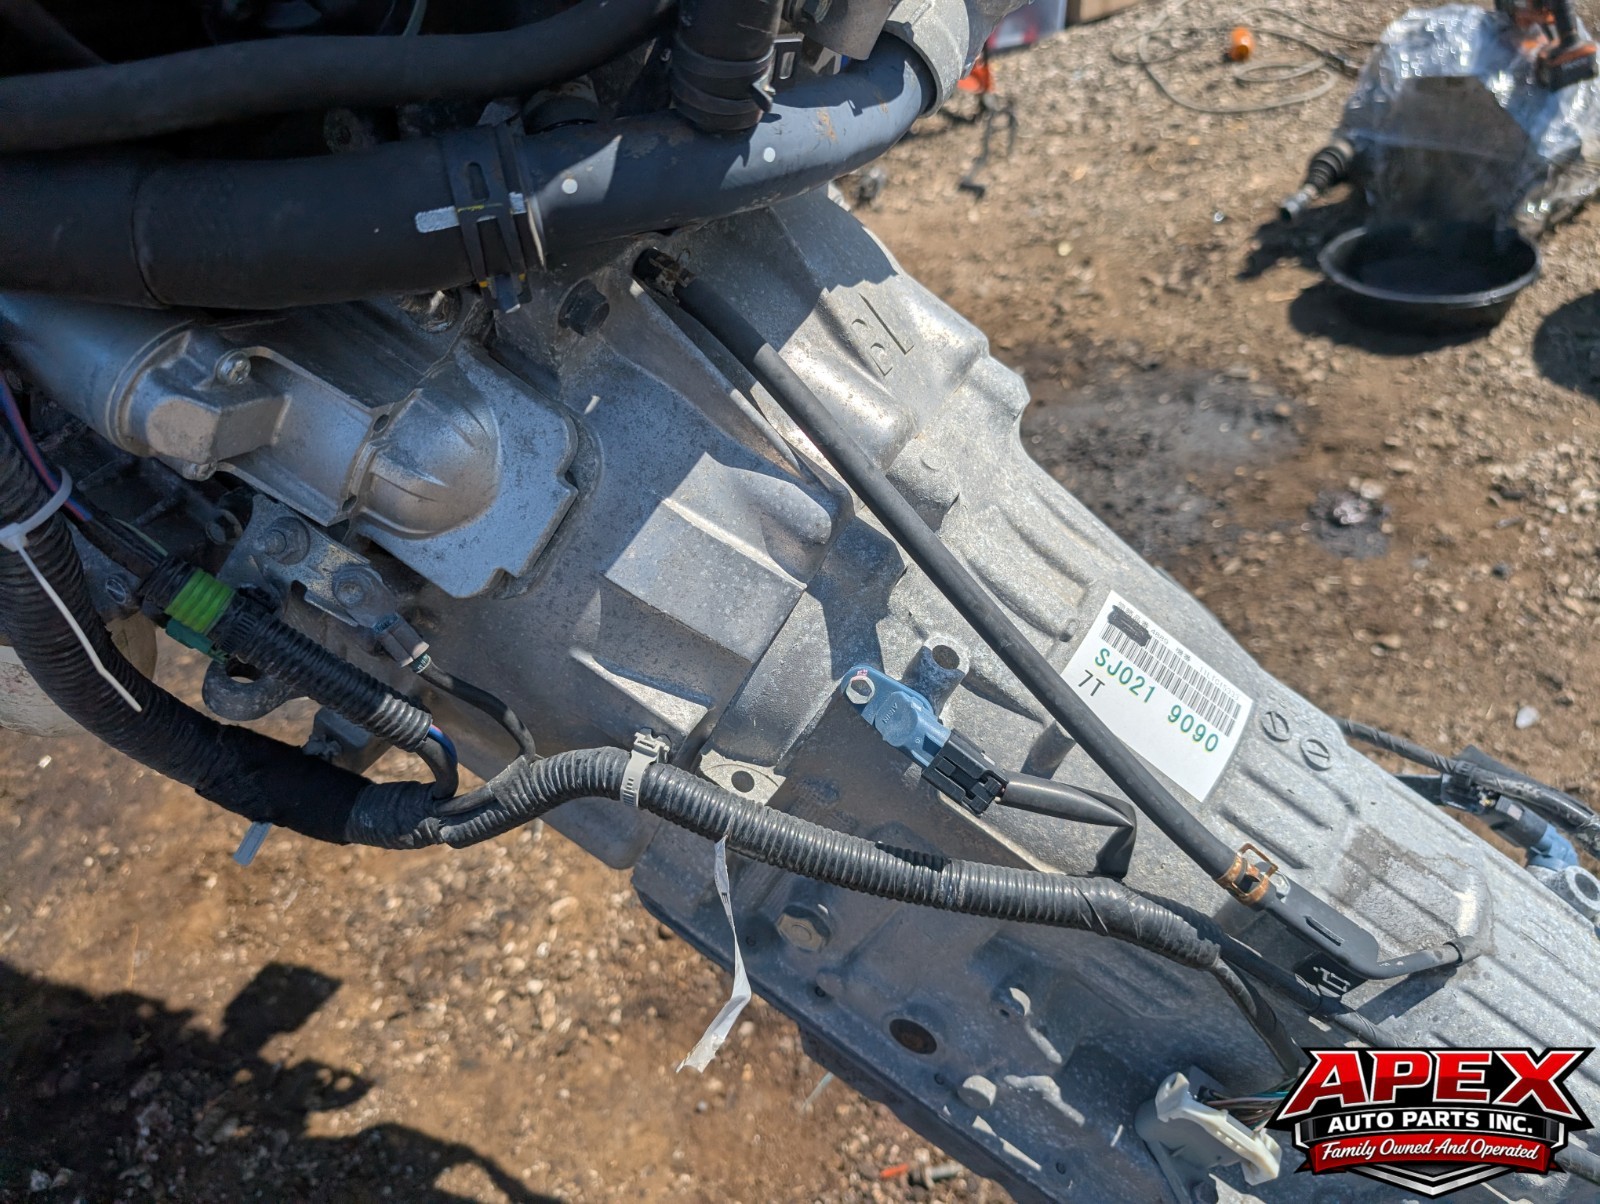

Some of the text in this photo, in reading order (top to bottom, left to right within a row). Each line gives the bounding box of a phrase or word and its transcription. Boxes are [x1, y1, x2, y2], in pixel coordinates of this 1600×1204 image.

[1077, 669, 1105, 697] 7T
[1094, 648, 1156, 703] SJ021
[1167, 705, 1219, 752] 9090
